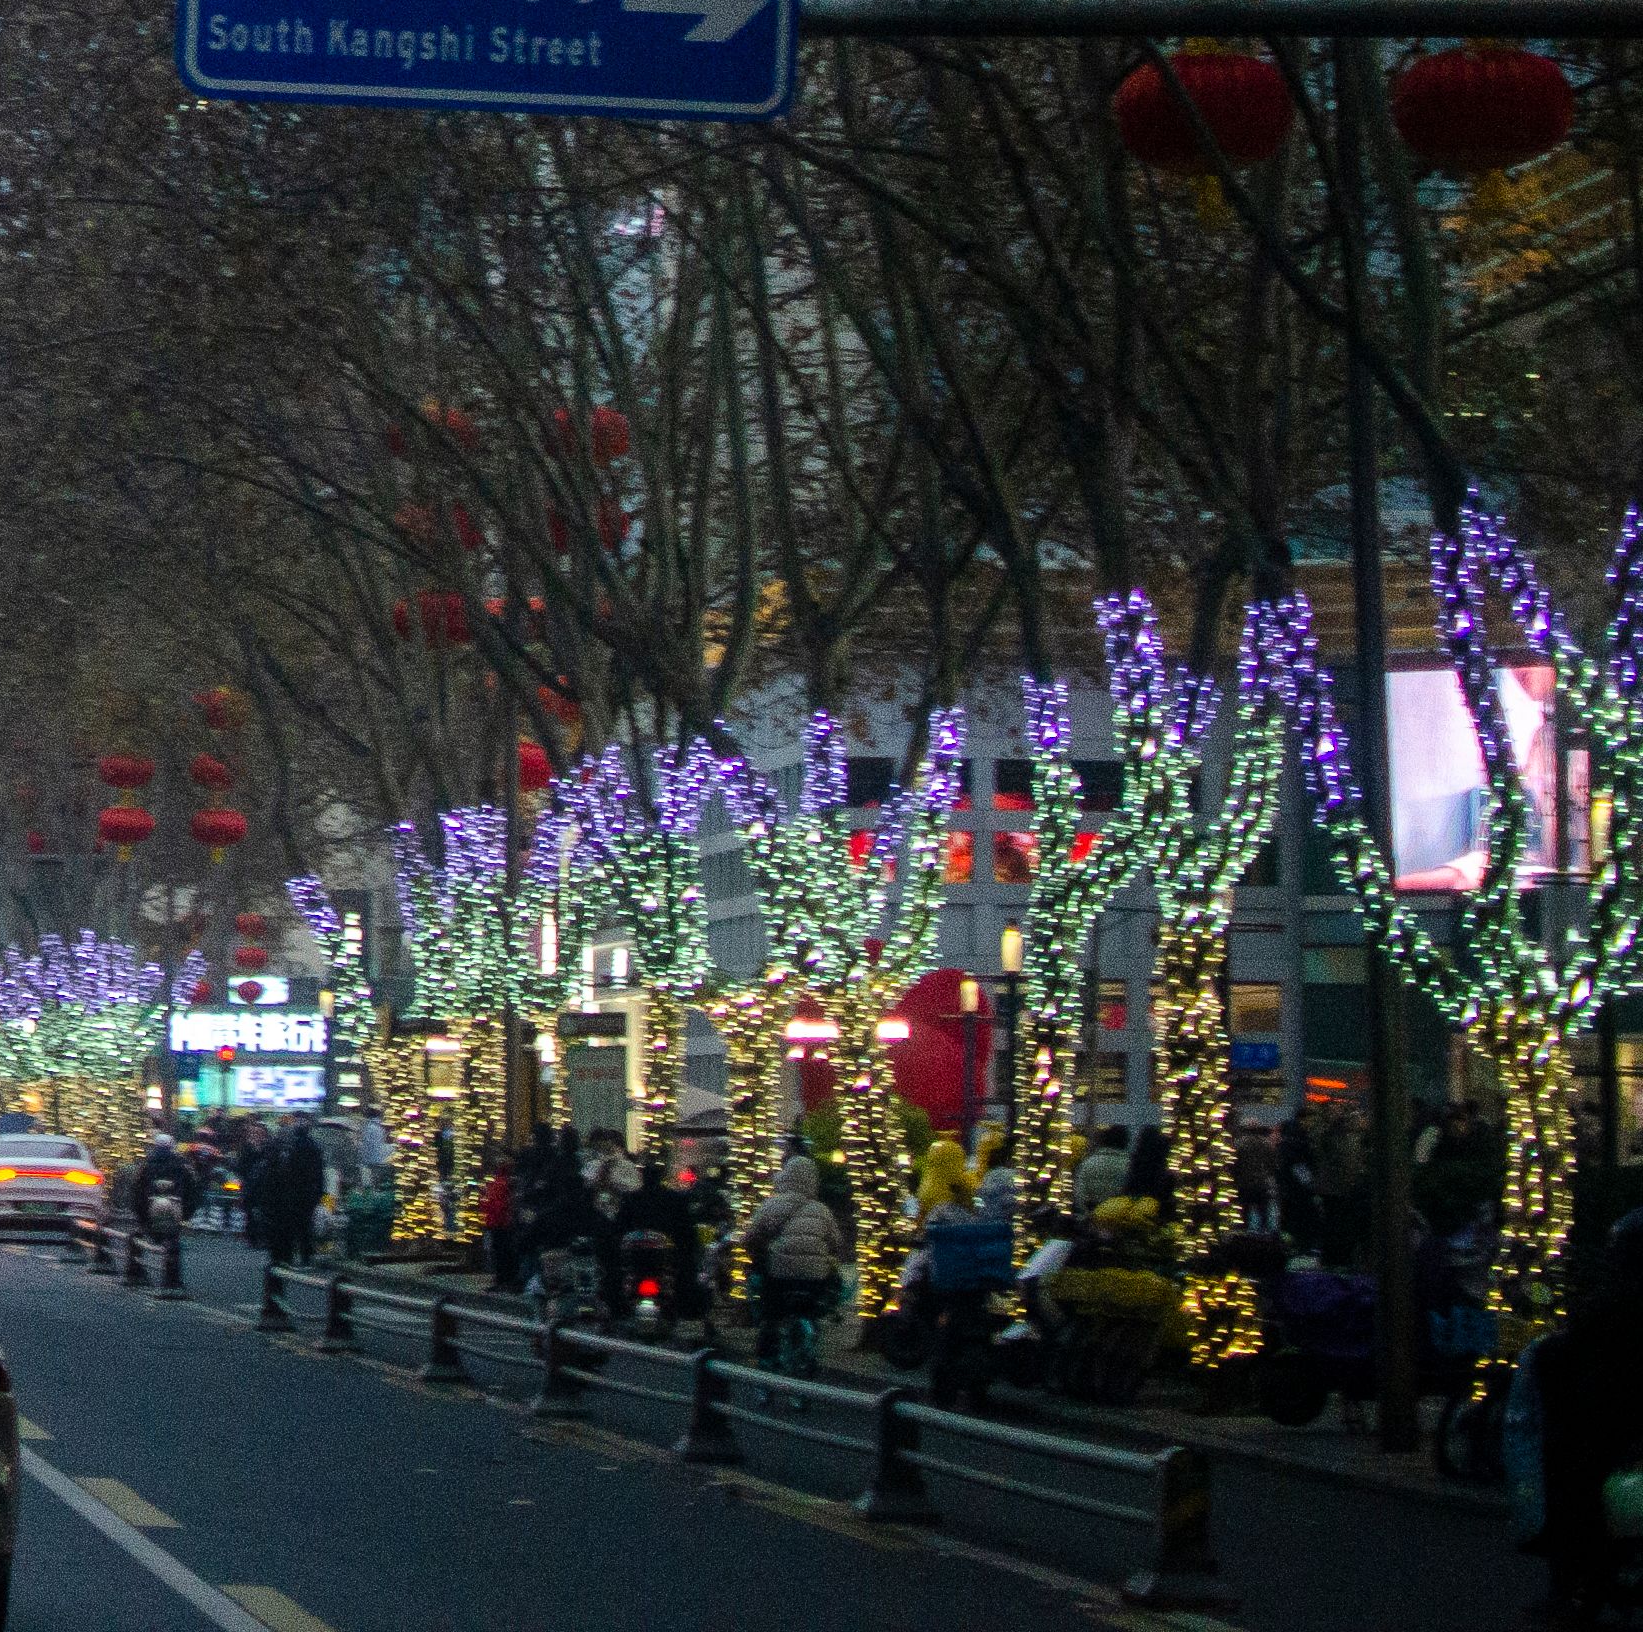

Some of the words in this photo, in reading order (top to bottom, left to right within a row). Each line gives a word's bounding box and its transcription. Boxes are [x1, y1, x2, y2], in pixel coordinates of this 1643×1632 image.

[207, 13, 314, 55] South
[327, 19, 475, 70] Kangshi
[489, 25, 603, 66] Street
